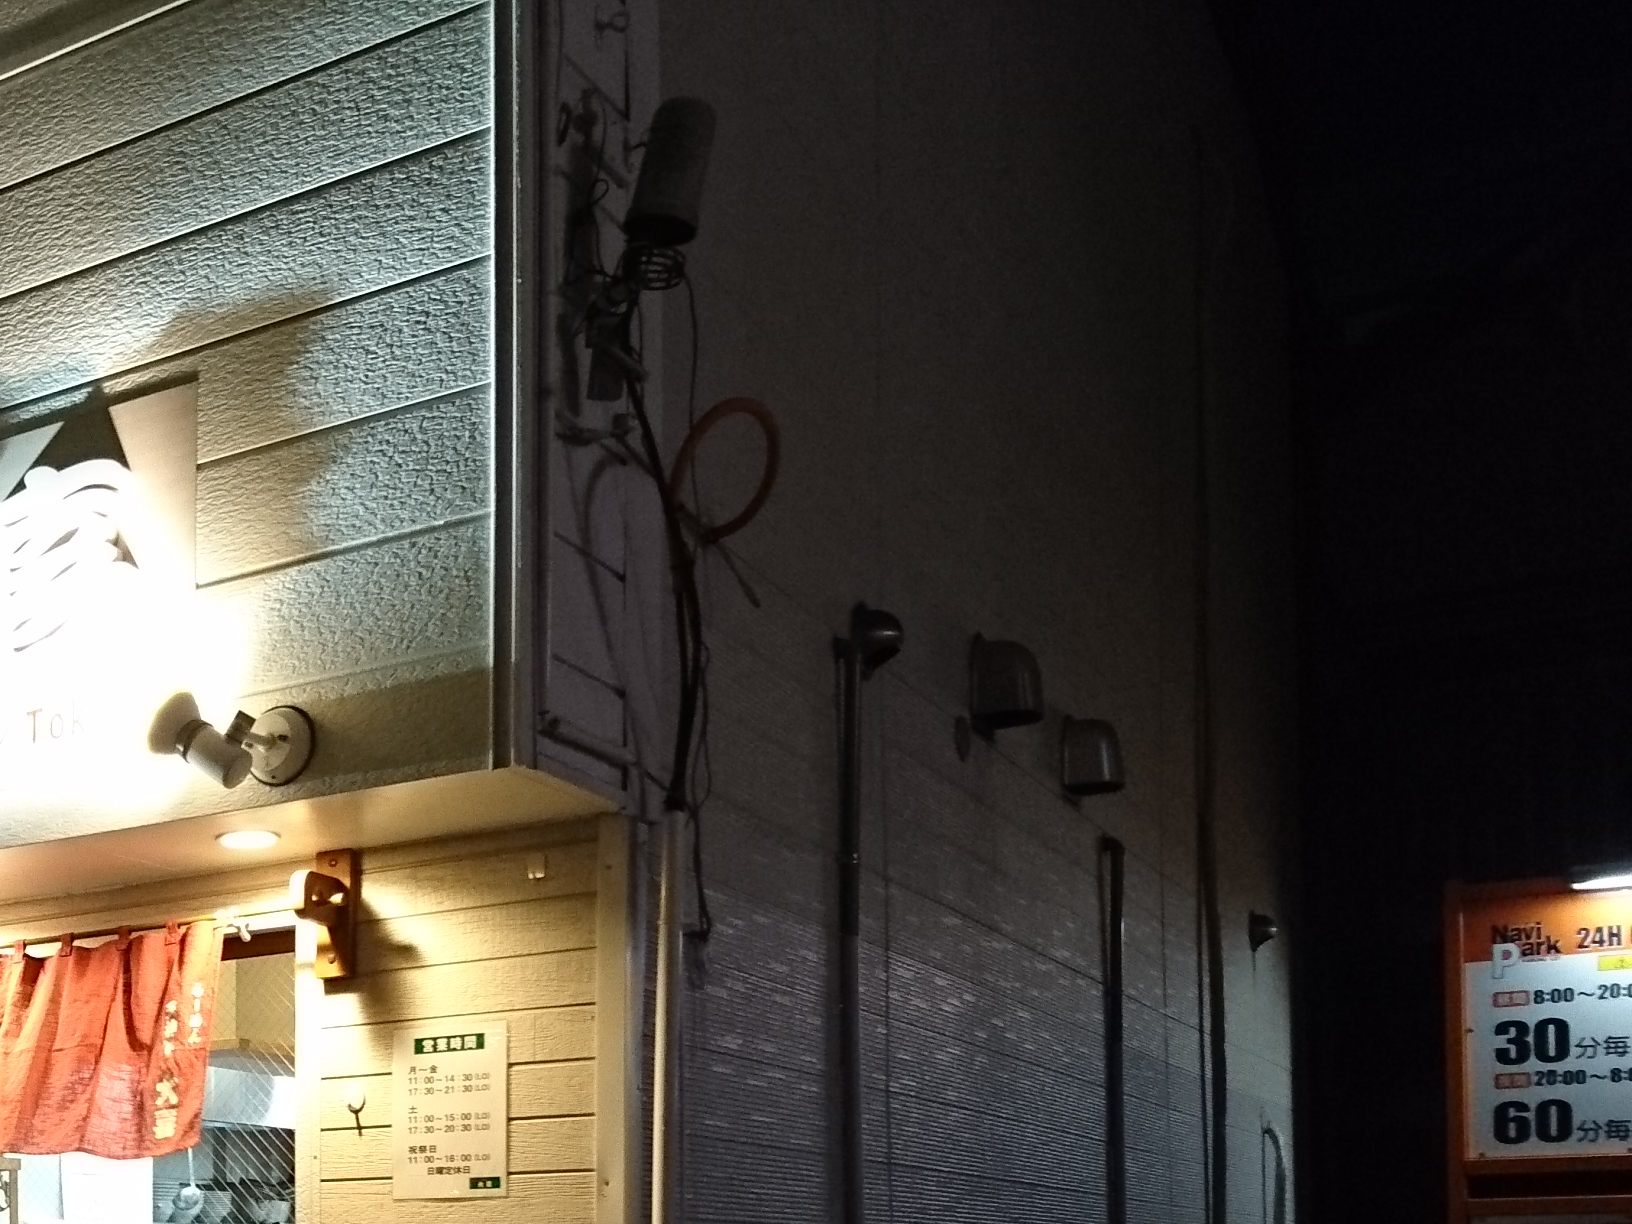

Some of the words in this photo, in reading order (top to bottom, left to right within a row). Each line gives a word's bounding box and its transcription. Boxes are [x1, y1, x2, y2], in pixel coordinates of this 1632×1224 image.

[1491, 921, 1542, 944] Navi
[1576, 925, 1622, 949] 24H
[1492, 935, 1563, 979] Park
[421, 1035, 477, 1053] 営業時間
[408, 1105, 418, 1114] 土
